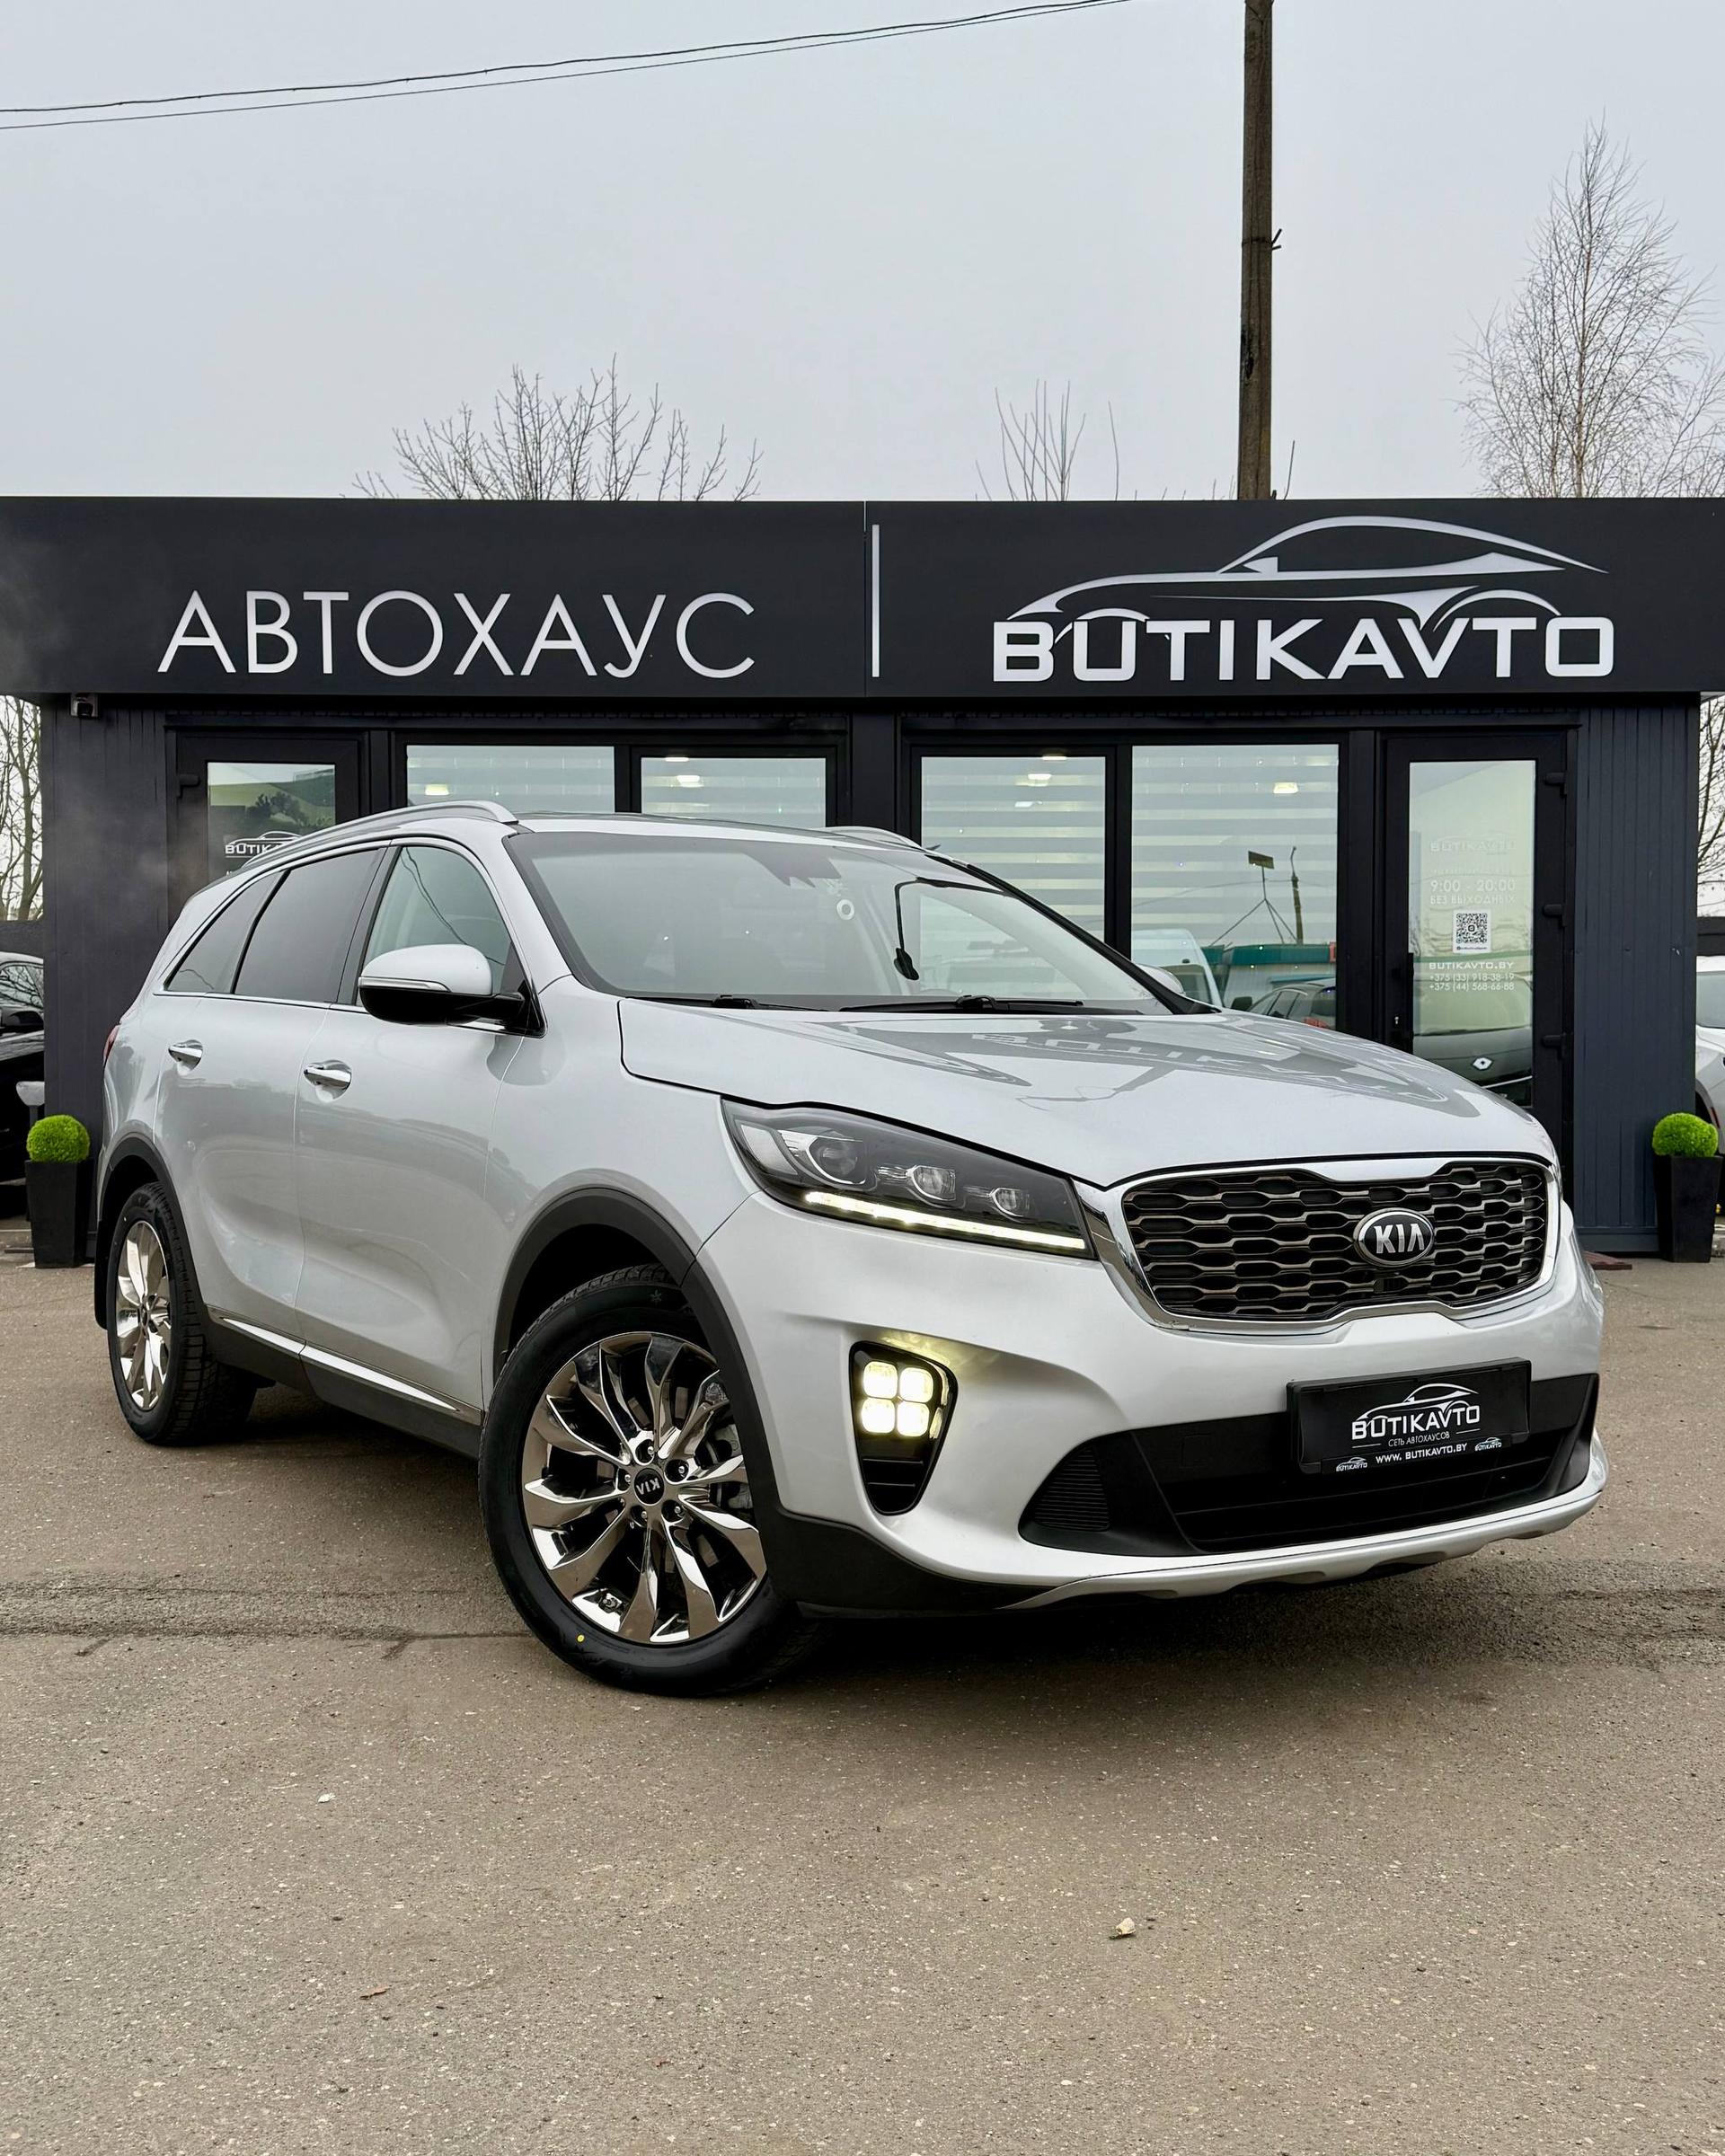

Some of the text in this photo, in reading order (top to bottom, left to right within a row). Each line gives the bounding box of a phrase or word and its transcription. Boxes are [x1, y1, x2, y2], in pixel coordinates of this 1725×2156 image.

[157, 589, 756, 678] АВТОХАУС
[993, 616, 1614, 683] BUTIKAVTO
[225, 844, 280, 854] BUTIK
[1430, 879, 1461, 892] 9:00
[1476, 879, 1516, 892] 20:00
[1429, 894, 1516, 905] БЕЗ ВЫХОДНЫХ
[1429, 961, 1515, 970] BUTIKAVTO.BY
[1429, 973, 1450, 982] +375
[1453, 972, 1469, 983] (33)
[1429, 982, 1515, 992] +375 (44) 568-66-88
[1374, 1223, 1425, 1254] KIA
[1351, 1405, 1481, 1440] BUTIKAVTO
[1388, 1431, 1450, 1447] СЕТЬ АВТОХАУСОВ
[1376, 1443, 1468, 1464] WWW. BUTIKAVTO.BY
[635, 1477, 661, 1495] KIA
